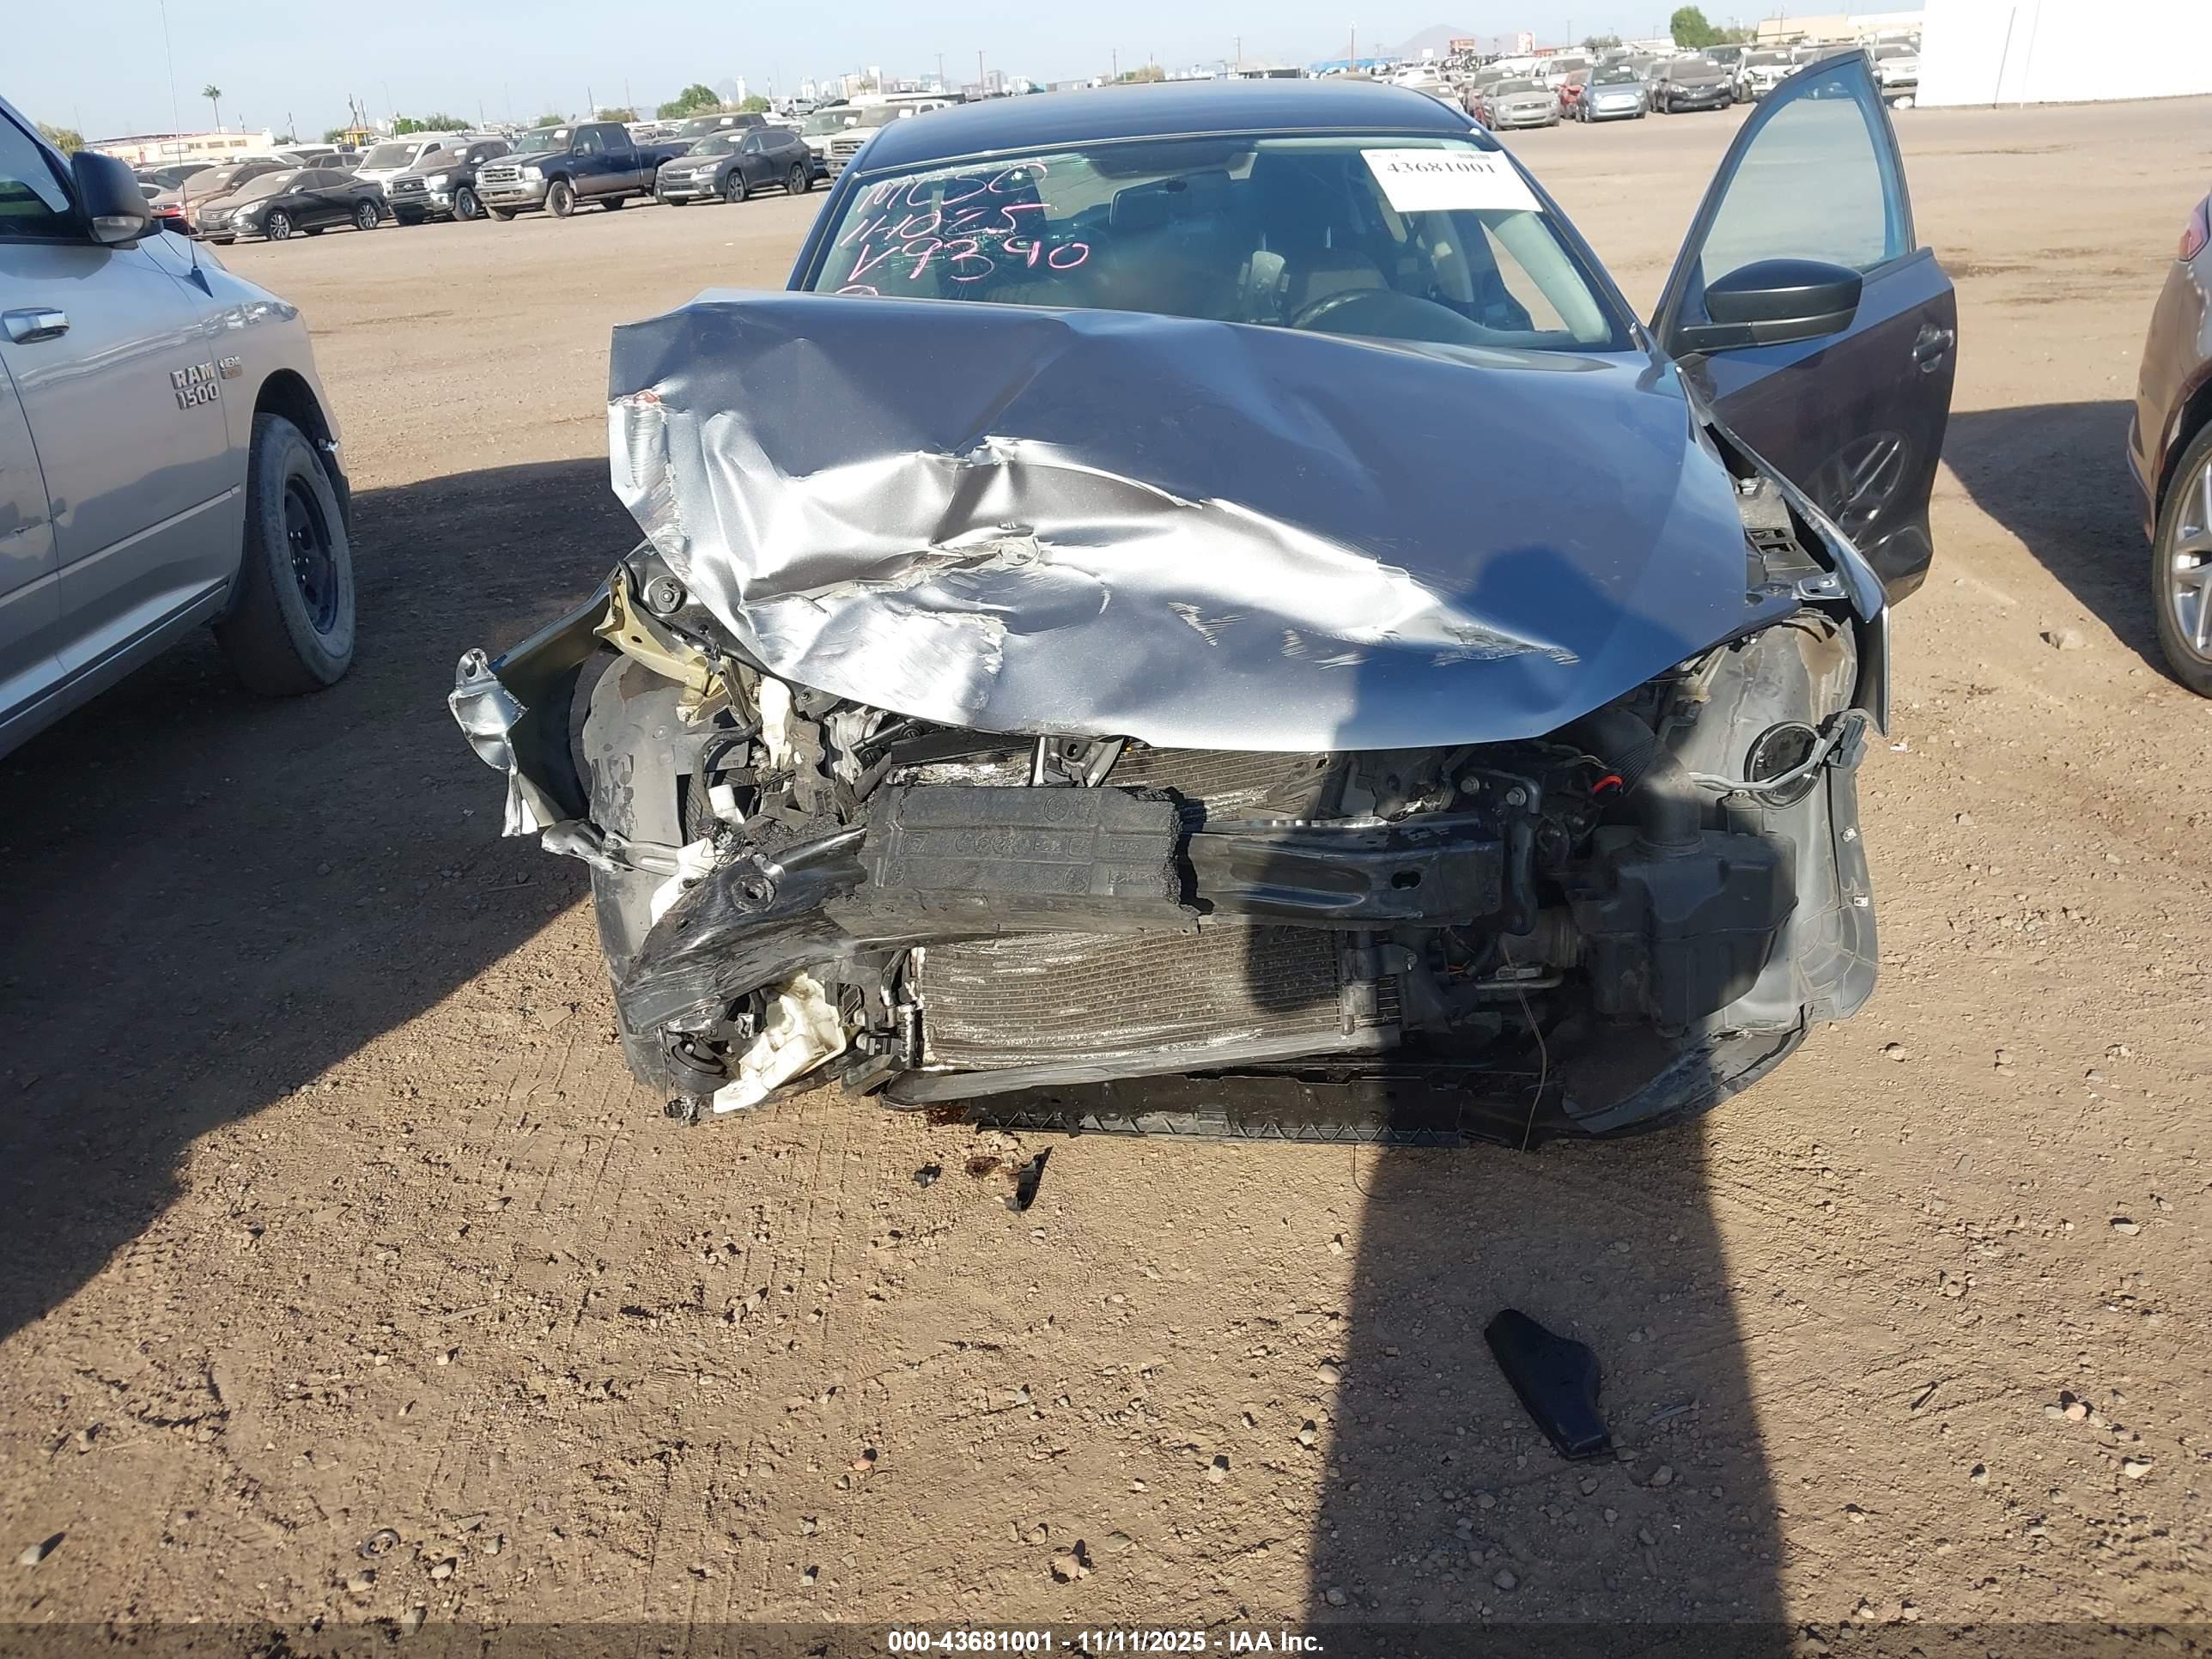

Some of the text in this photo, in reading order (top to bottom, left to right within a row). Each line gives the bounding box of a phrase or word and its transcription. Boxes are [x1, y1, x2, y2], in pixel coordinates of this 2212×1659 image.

[1387, 162, 1496, 173] 43681001
[171, 362, 215, 389] RAM
[175, 381, 219, 410] 1500
